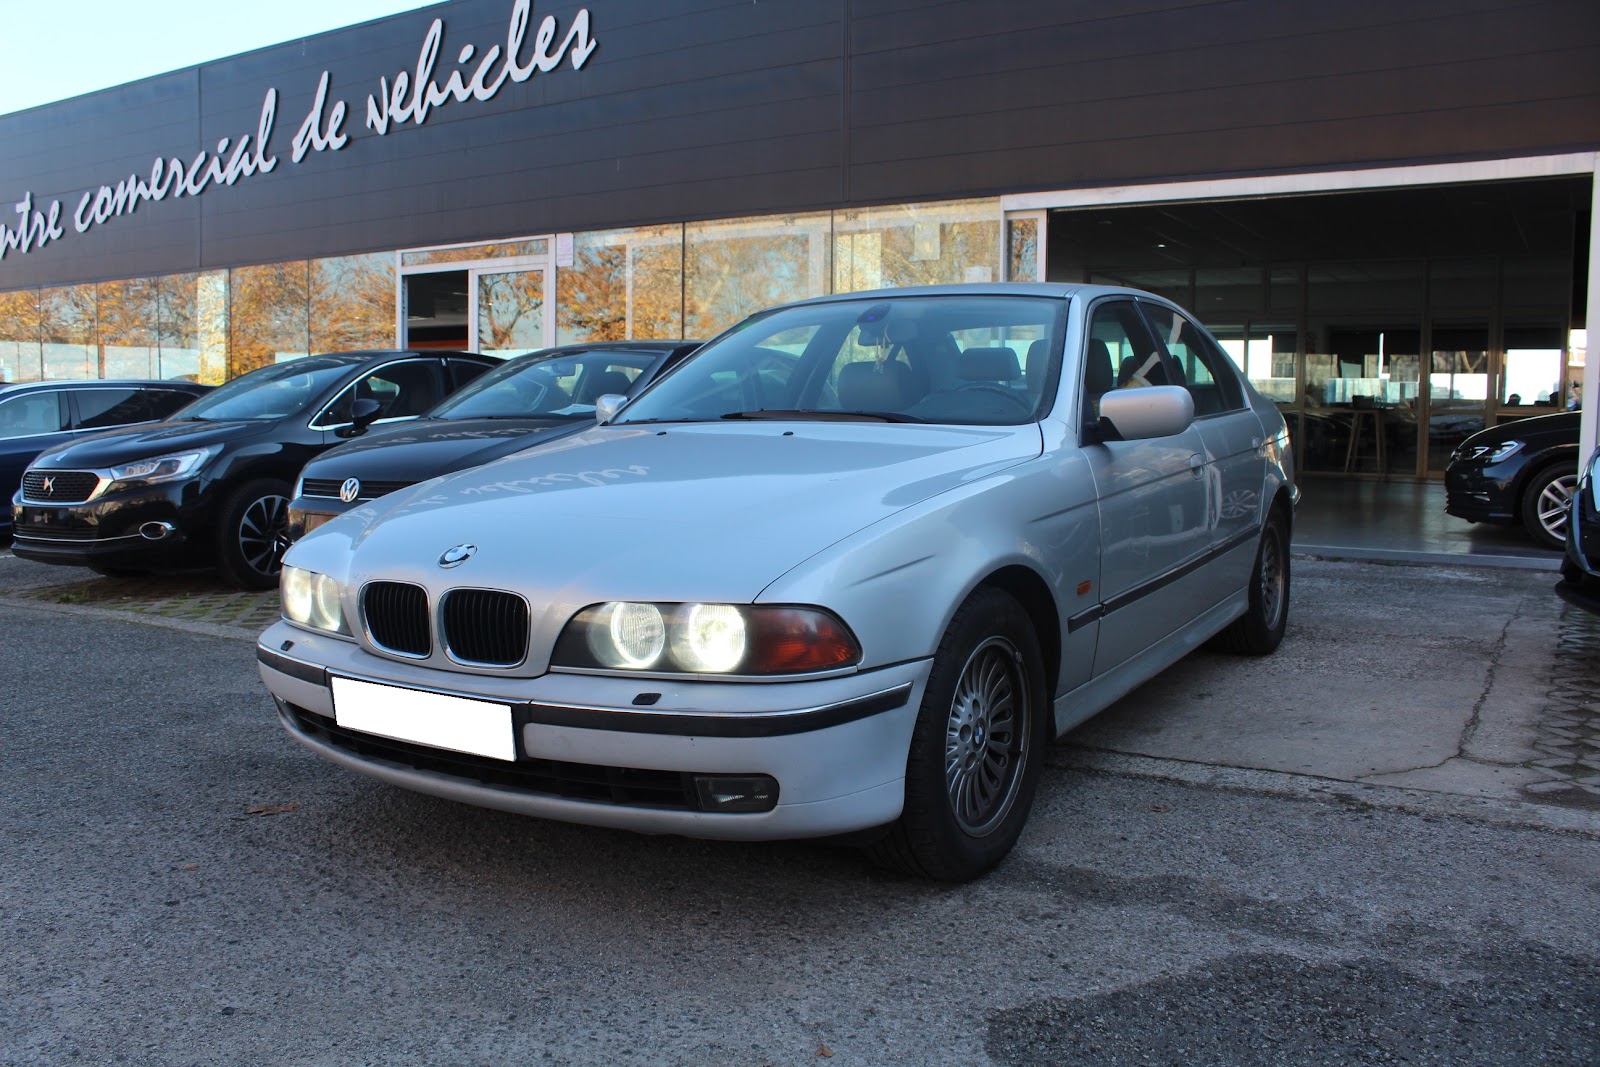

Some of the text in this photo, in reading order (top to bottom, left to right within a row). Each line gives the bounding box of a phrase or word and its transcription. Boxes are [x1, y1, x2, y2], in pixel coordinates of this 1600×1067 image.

[74, 88, 277, 232] comercial
[292, 71, 347, 163] de
[366, 0, 597, 135] vehicles
